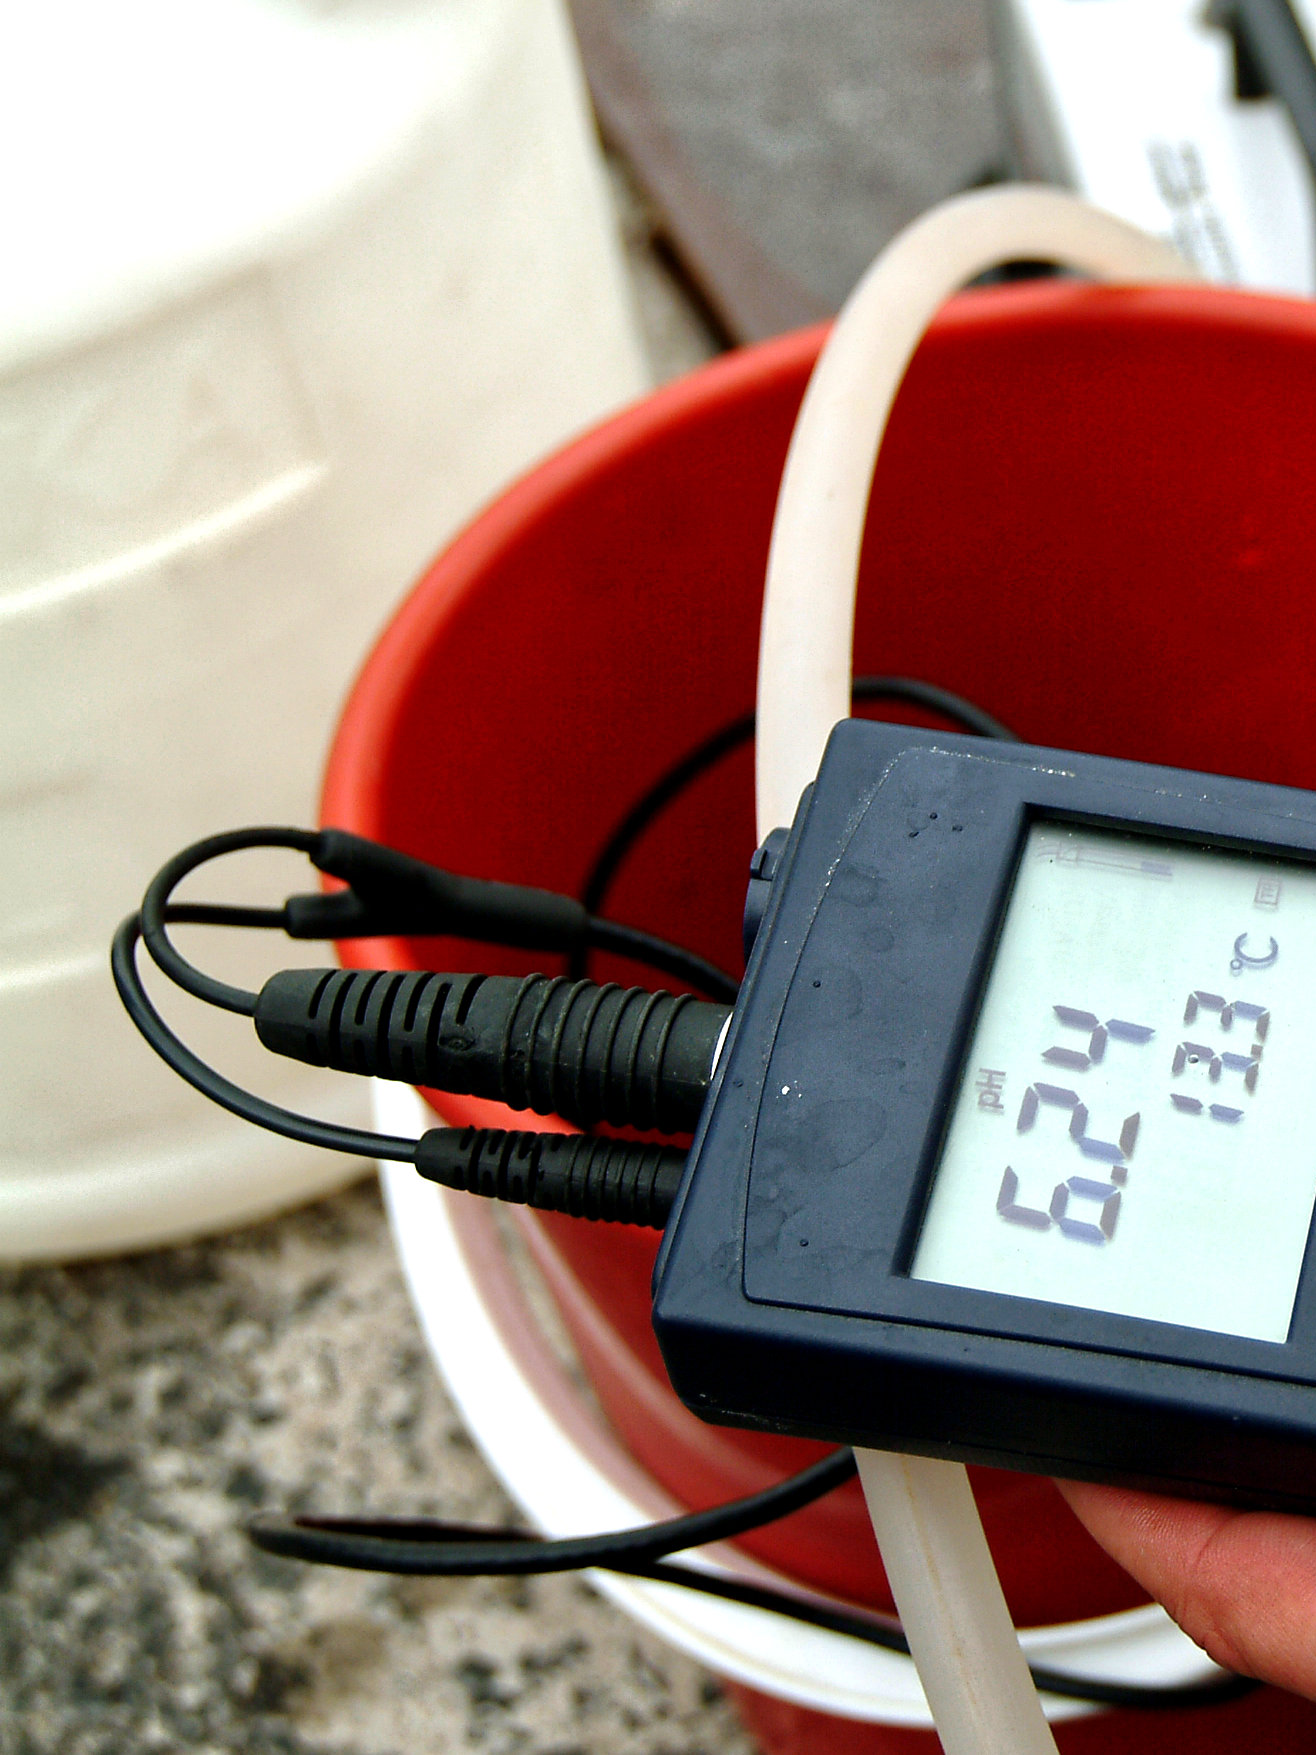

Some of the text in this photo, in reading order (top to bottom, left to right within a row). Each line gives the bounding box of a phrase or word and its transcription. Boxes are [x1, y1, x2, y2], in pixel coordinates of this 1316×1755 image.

[977, 1005, 1156, 1245] pH 6.24
[1170, 991, 1271, 1123] 13.3
